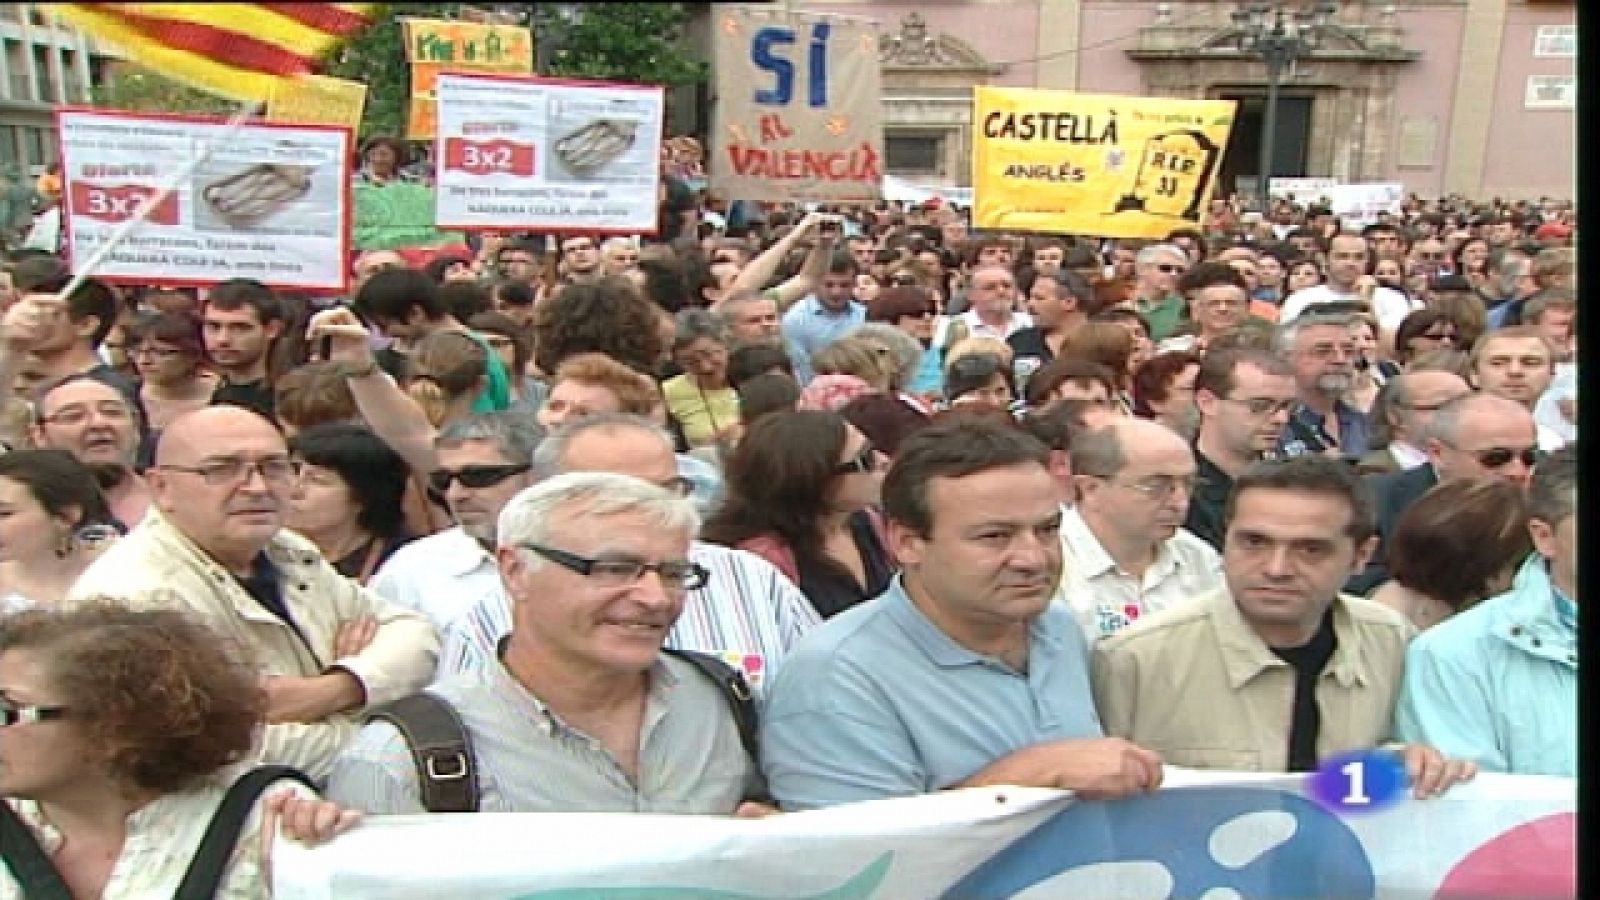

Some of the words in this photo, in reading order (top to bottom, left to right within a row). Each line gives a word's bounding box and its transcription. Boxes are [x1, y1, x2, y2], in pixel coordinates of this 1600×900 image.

[752, 23, 831, 109] SÍ
[984, 107, 1118, 145] CASTELLÀ
[462, 145, 514, 168] 3x2
[727, 140, 882, 183] VALENCIÀ
